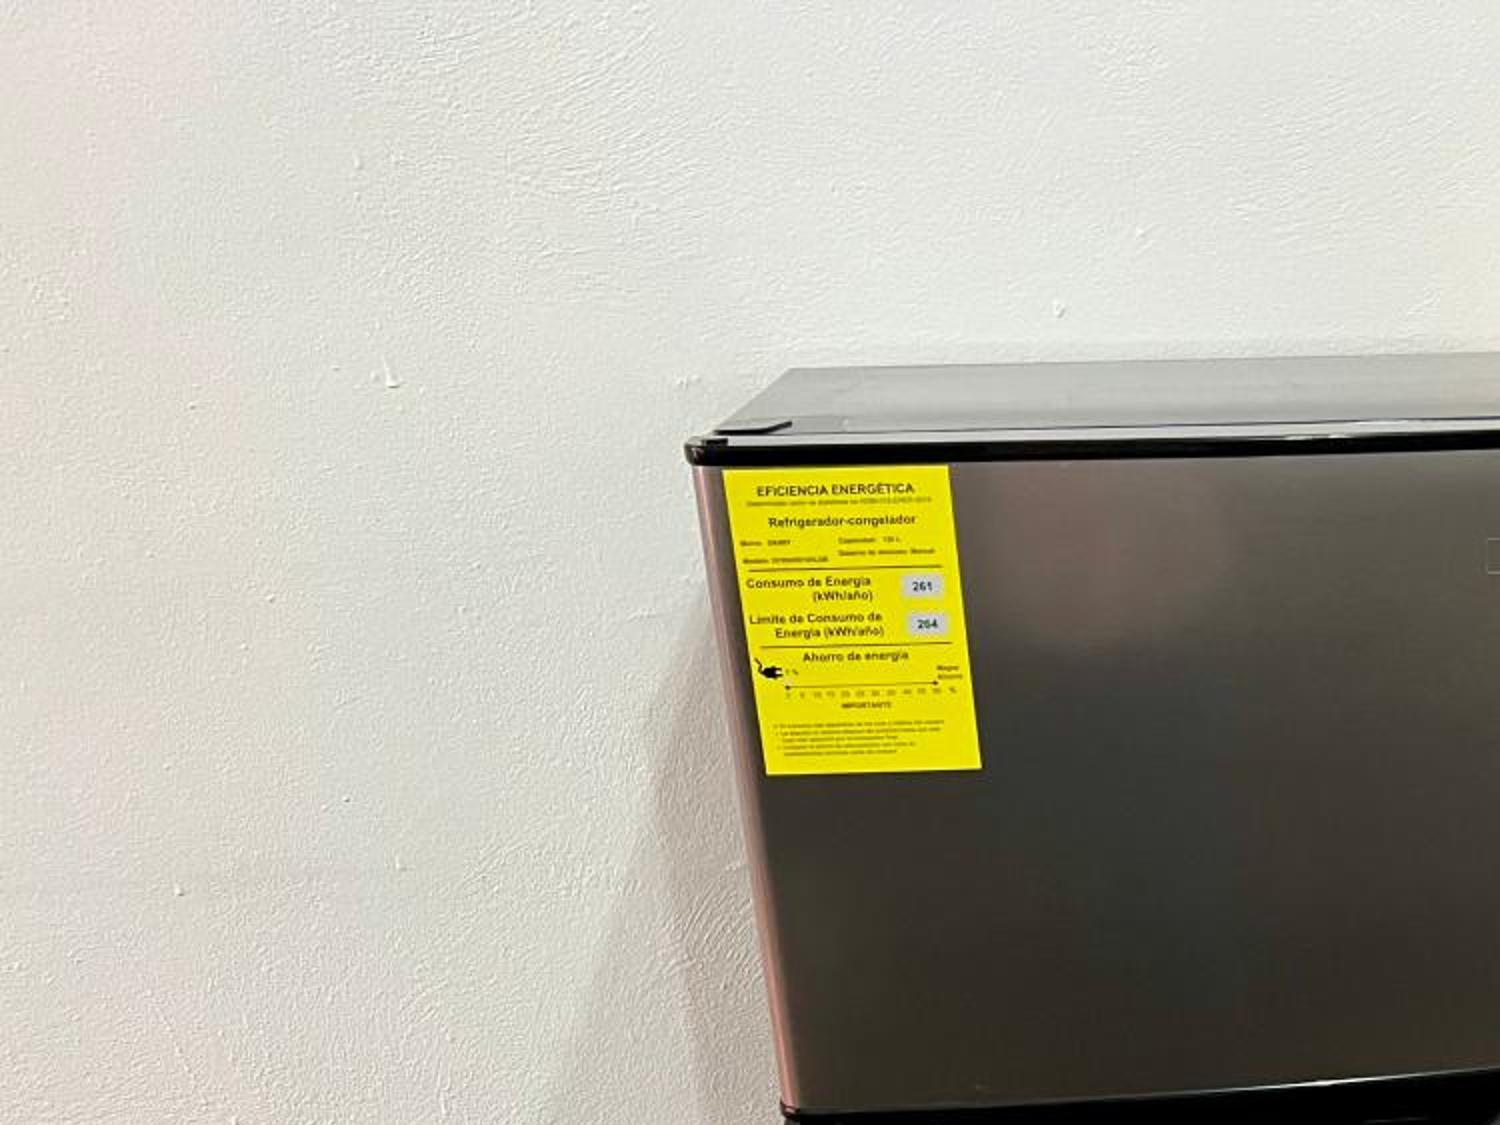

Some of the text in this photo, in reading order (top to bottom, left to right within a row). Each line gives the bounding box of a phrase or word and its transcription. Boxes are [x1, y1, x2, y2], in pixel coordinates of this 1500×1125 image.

[757, 482, 915, 498] EFICIENCIA ENERGÉTICA
[768, 515, 917, 529] Refrigerador-congelador
[746, 577, 804, 589] Consumo
[807, 577, 821, 587] de
[912, 581, 933, 592] 261
[813, 589, 873, 602] (kWh/año)
[789, 613, 804, 624] de
[807, 612, 865, 623] Consumo
[867, 611, 883, 622] de
[823, 625, 885, 639] (kWh/año)
[803, 652, 844, 662] Ahorro
[847, 651, 861, 661] de
